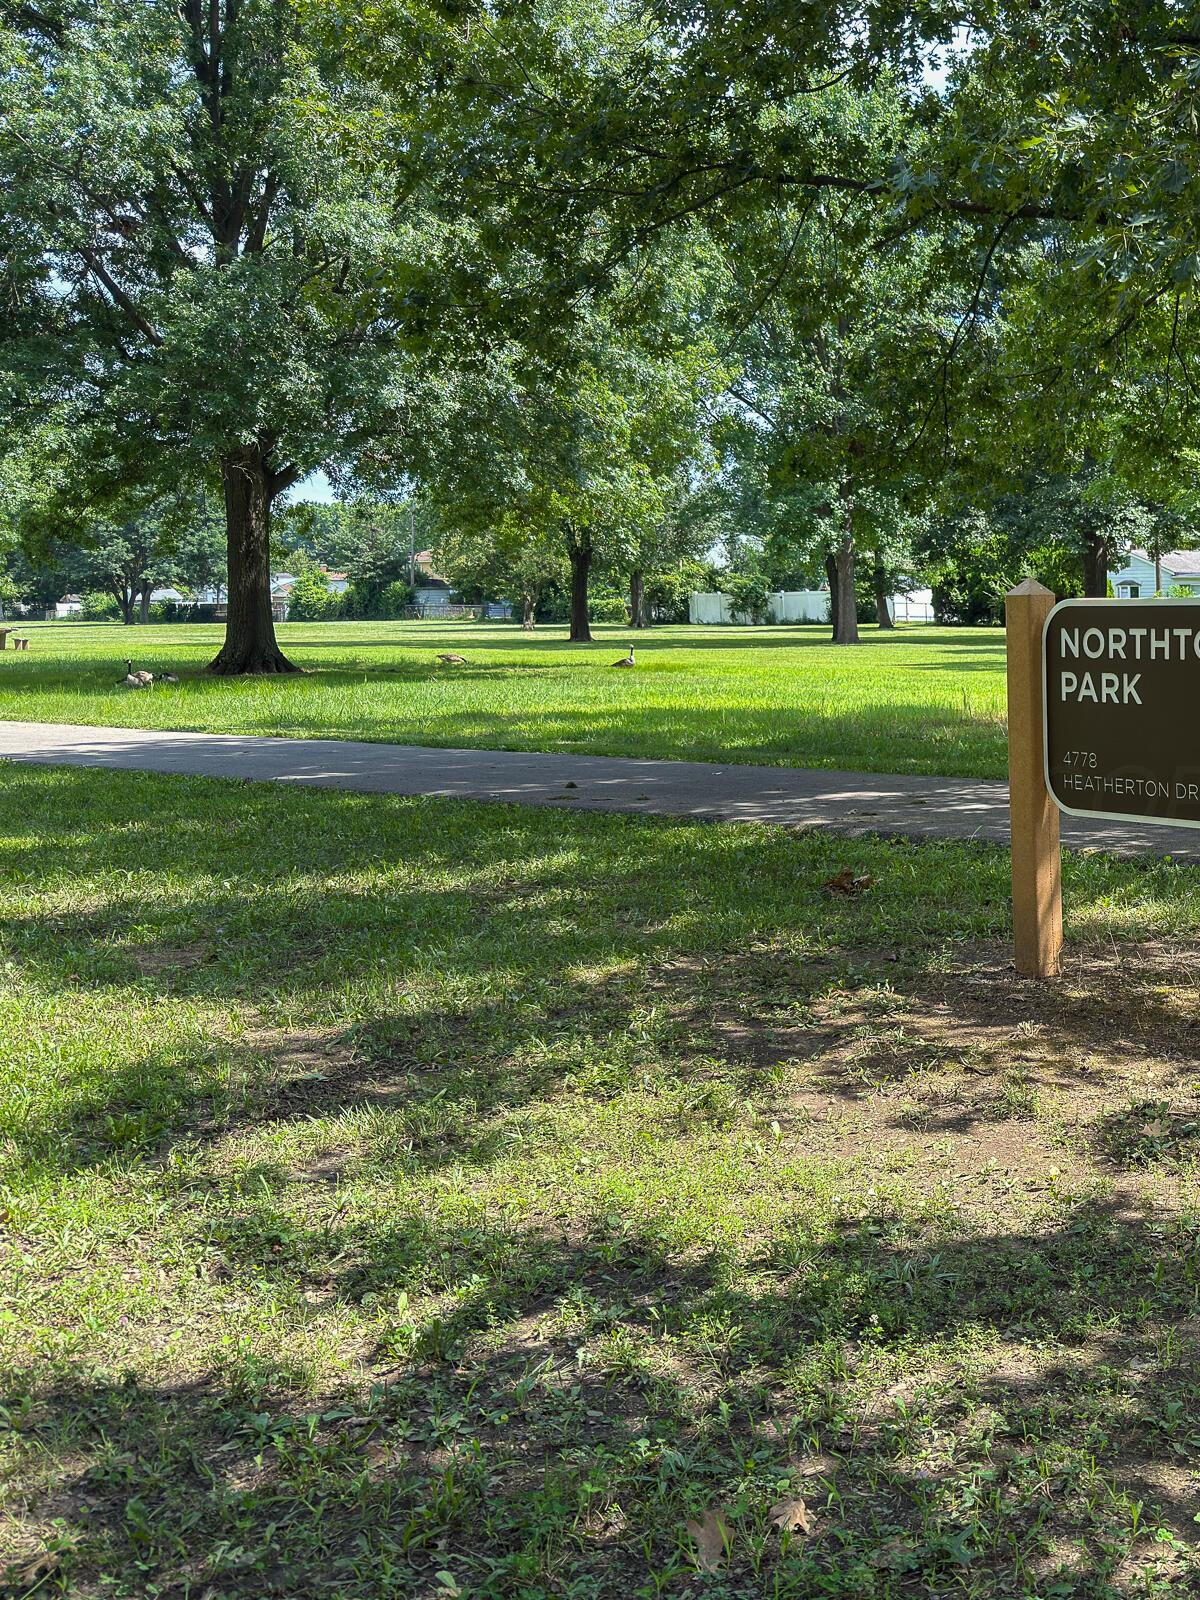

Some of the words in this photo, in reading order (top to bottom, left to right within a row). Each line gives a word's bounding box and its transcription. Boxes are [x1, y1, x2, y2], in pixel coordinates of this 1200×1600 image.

[1061, 671, 1143, 705] PARK
[1062, 751, 1098, 769] 4778
[1063, 773, 1169, 798] HEATHERTON
[1175, 782, 1199, 801] DR
